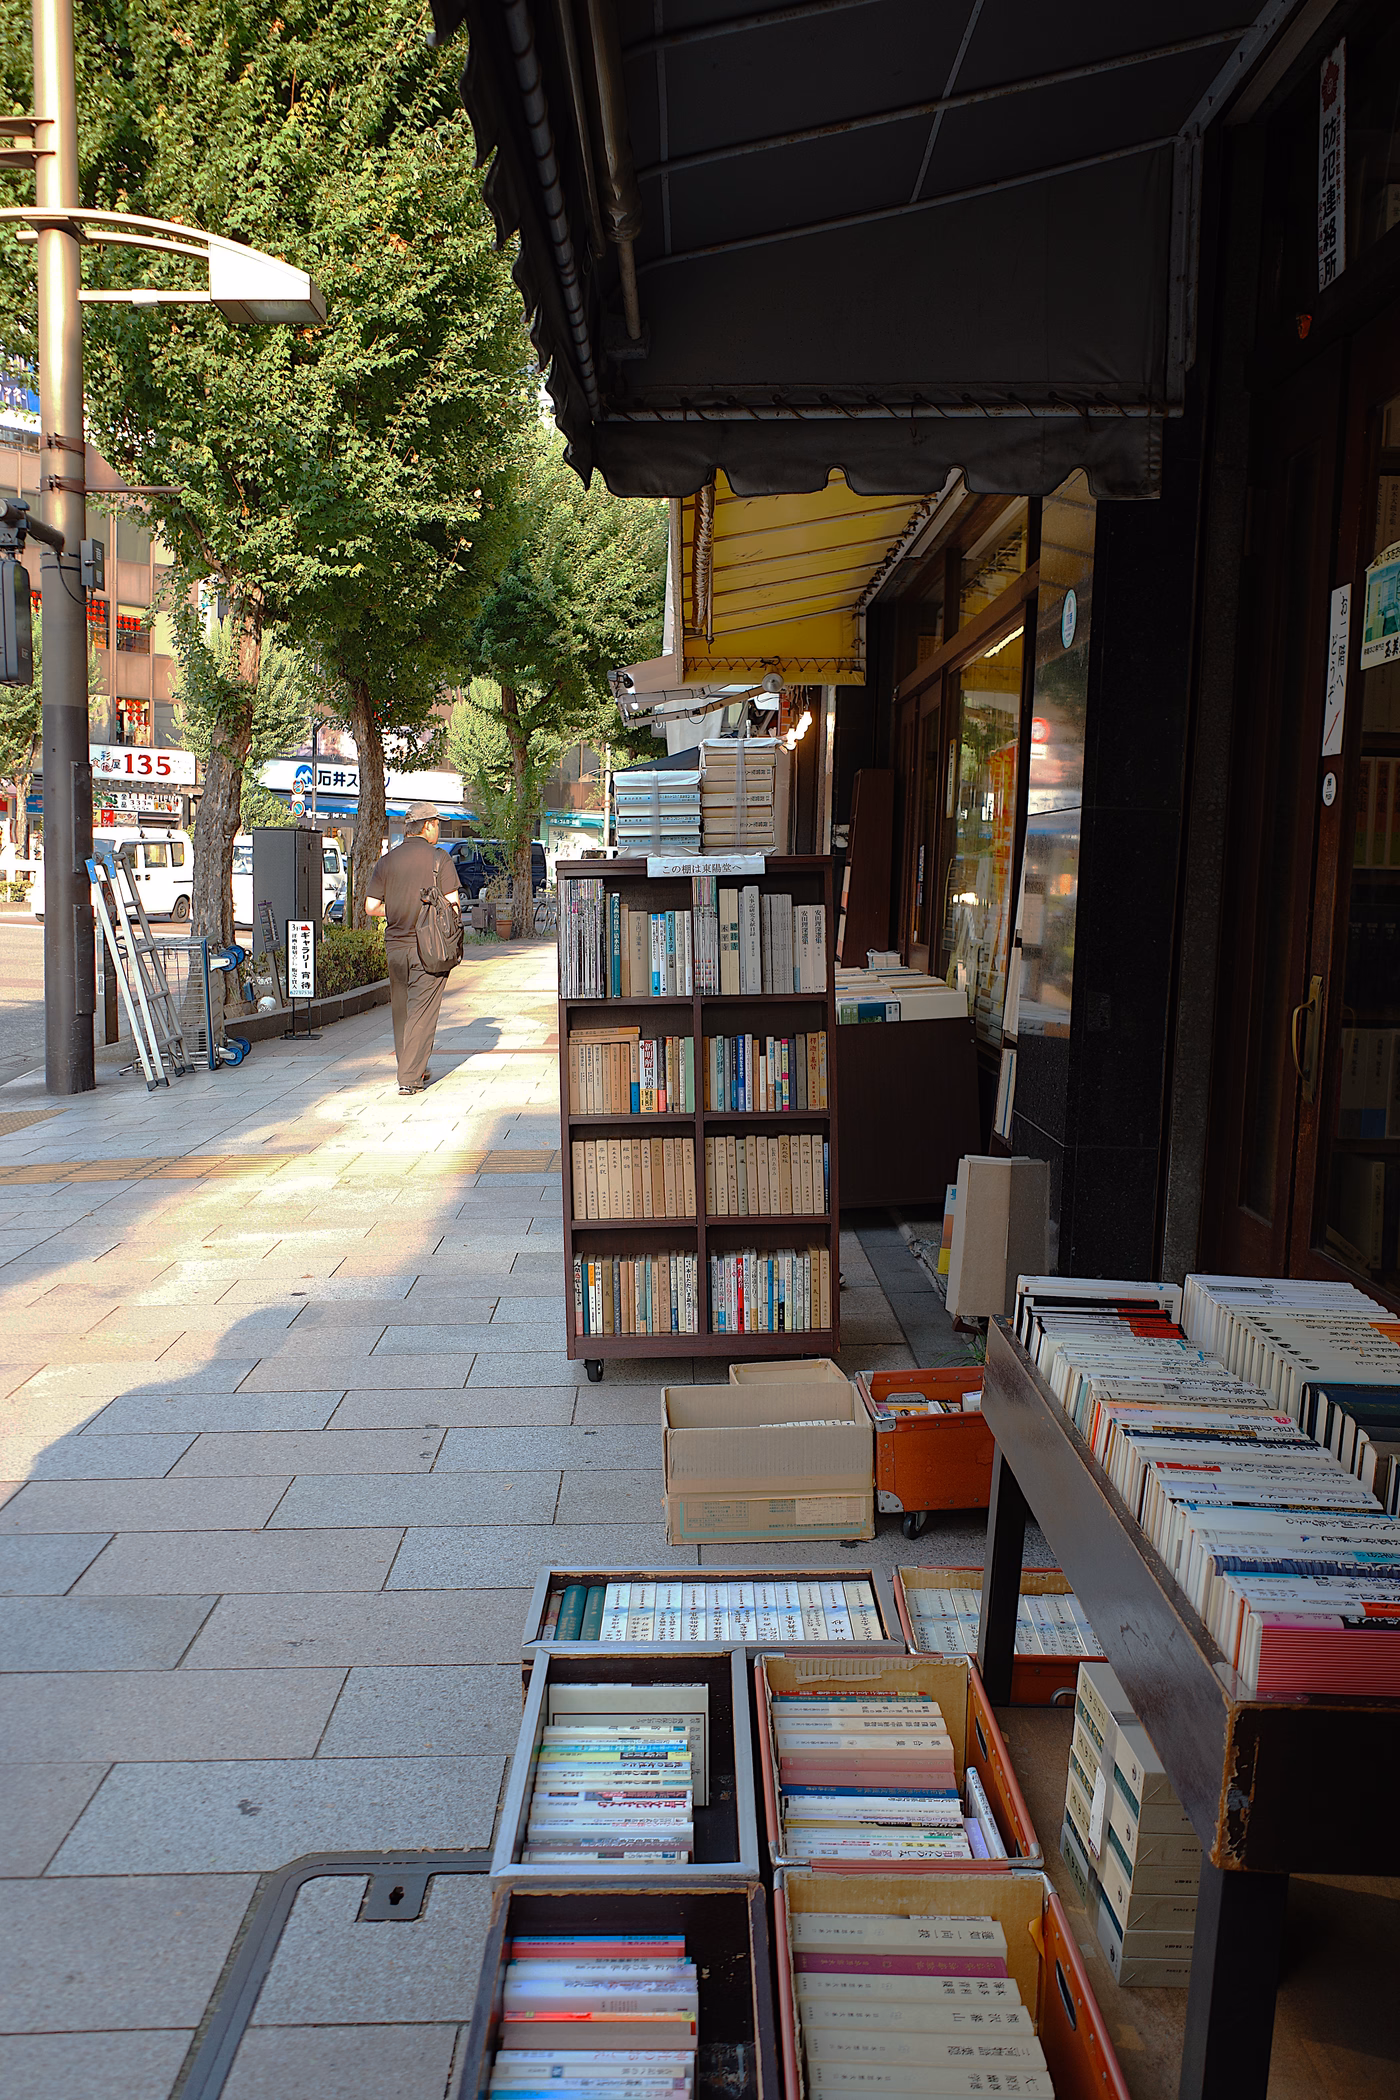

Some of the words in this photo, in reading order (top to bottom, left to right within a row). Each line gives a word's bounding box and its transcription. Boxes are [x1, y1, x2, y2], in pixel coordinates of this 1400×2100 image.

[1322, 117, 1338, 285] 防犯連絡所
[124, 753, 171, 776] 135
[662, 862, 742, 875] この棚は東陽堂へ
[300, 932, 311, 968] ギャラリー
[300, 971, 311, 990] 宵待
[894, 1739, 941, 1747] 歌合集
[917, 1928, 963, 1940] 一向一揆
[951, 2012, 1020, 2023] 熊沢蕃山
